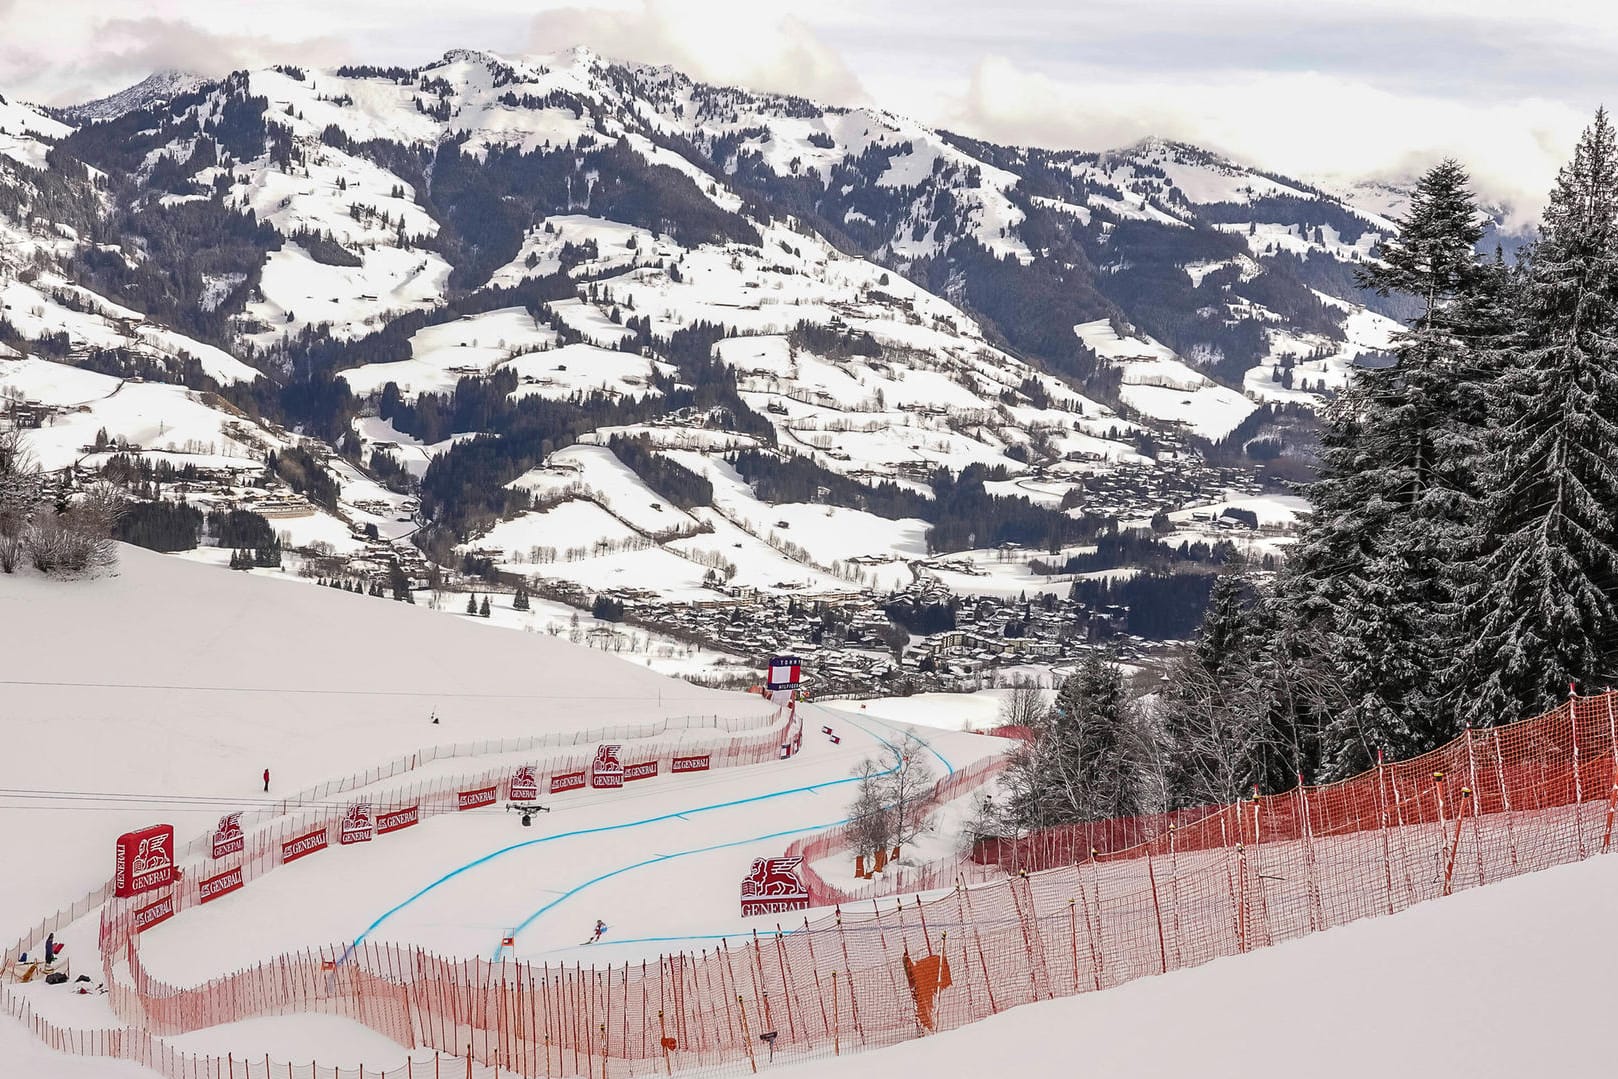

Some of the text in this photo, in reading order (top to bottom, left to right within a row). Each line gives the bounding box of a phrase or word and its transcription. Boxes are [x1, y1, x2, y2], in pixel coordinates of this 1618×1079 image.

[631, 765, 657, 777] GENERALI
[682, 757, 709, 769] GENERALI
[559, 774, 585, 787] GENERALI
[467, 790, 496, 803] GENERALI
[386, 810, 417, 827] GENERALI
[292, 832, 327, 854] GENERALI
[117, 844, 125, 889] GENERALI
[132, 868, 171, 890] GENERALI
[210, 870, 241, 894] GENERALI
[144, 899, 172, 923] GENERALI
[742, 901, 809, 916] GENERALI
